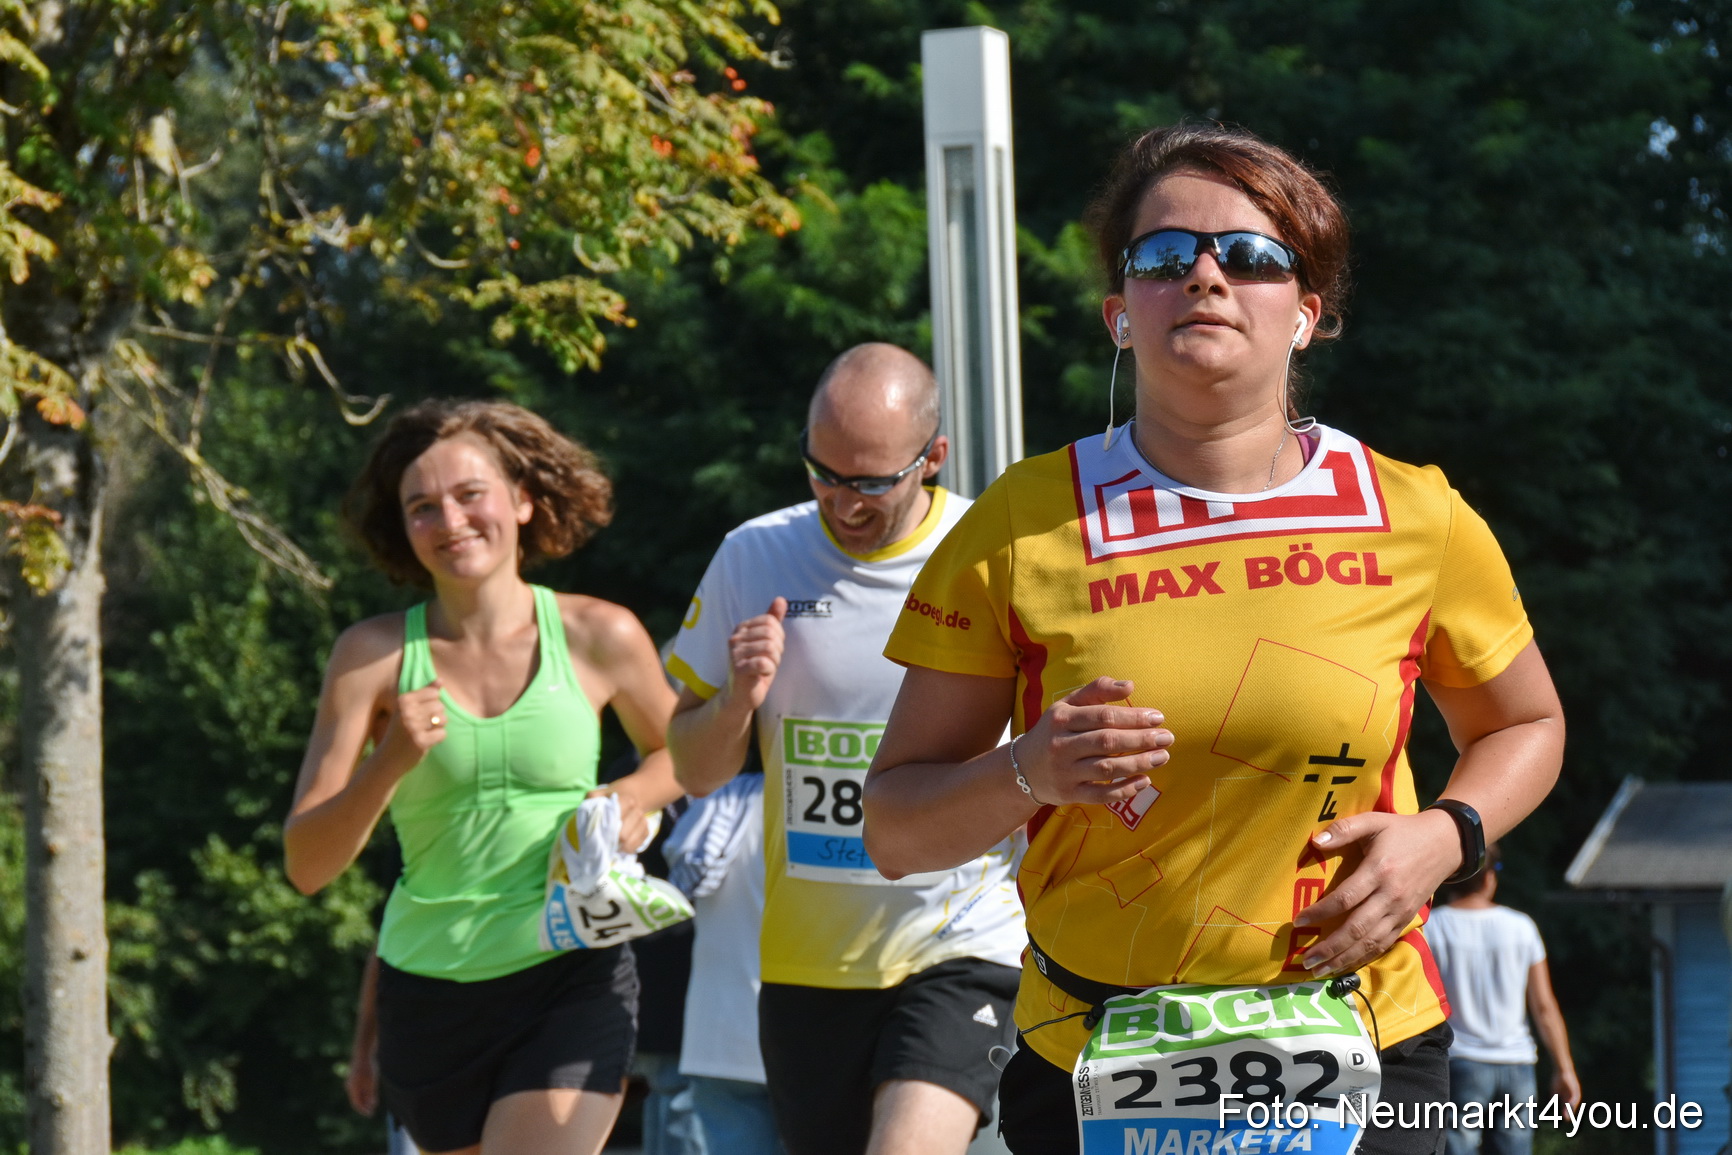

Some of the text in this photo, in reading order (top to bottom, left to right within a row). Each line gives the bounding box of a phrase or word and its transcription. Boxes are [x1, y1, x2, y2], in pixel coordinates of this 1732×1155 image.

[1087, 542, 1393, 614] MAX BÖGL
[787, 599, 832, 613] OCK
[1102, 984, 1334, 1047] BOCK
[1110, 1049, 1340, 1111] 2382
[1351, 1052, 1365, 1066] D
[1123, 1126, 1313, 1155] MARKETA
